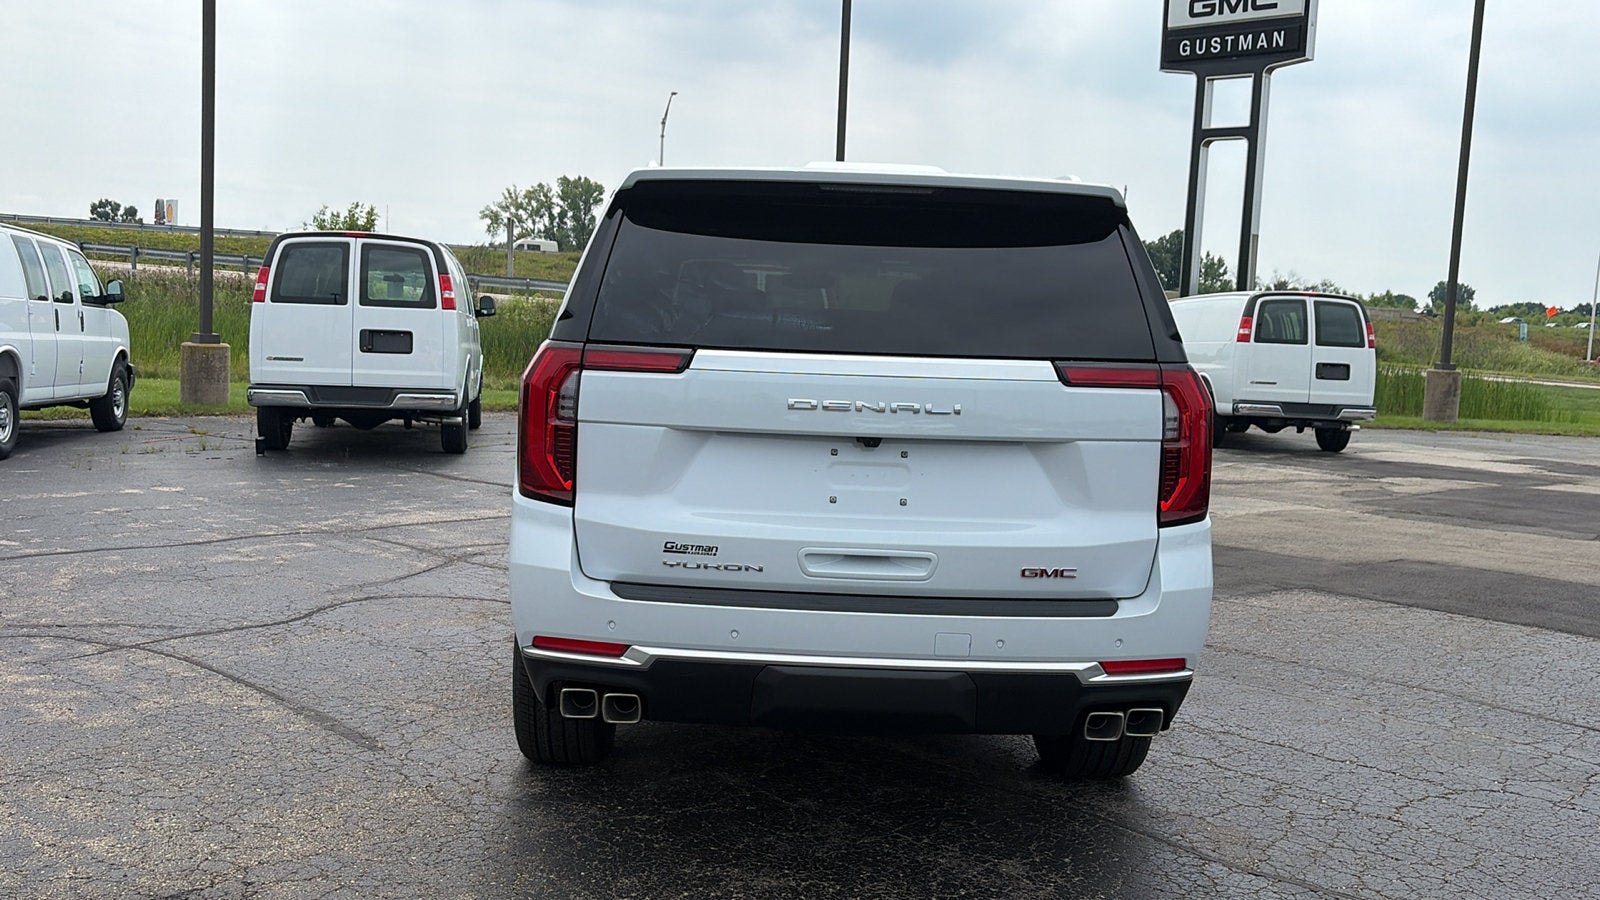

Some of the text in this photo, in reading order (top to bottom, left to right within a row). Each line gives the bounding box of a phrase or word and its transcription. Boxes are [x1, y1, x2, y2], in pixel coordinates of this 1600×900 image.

[1179, 30, 1285, 56] GUSTMAN
[787, 398, 961, 416] DENALI
[662, 560, 764, 573] YUKON
[1021, 566, 1078, 579] GMC
